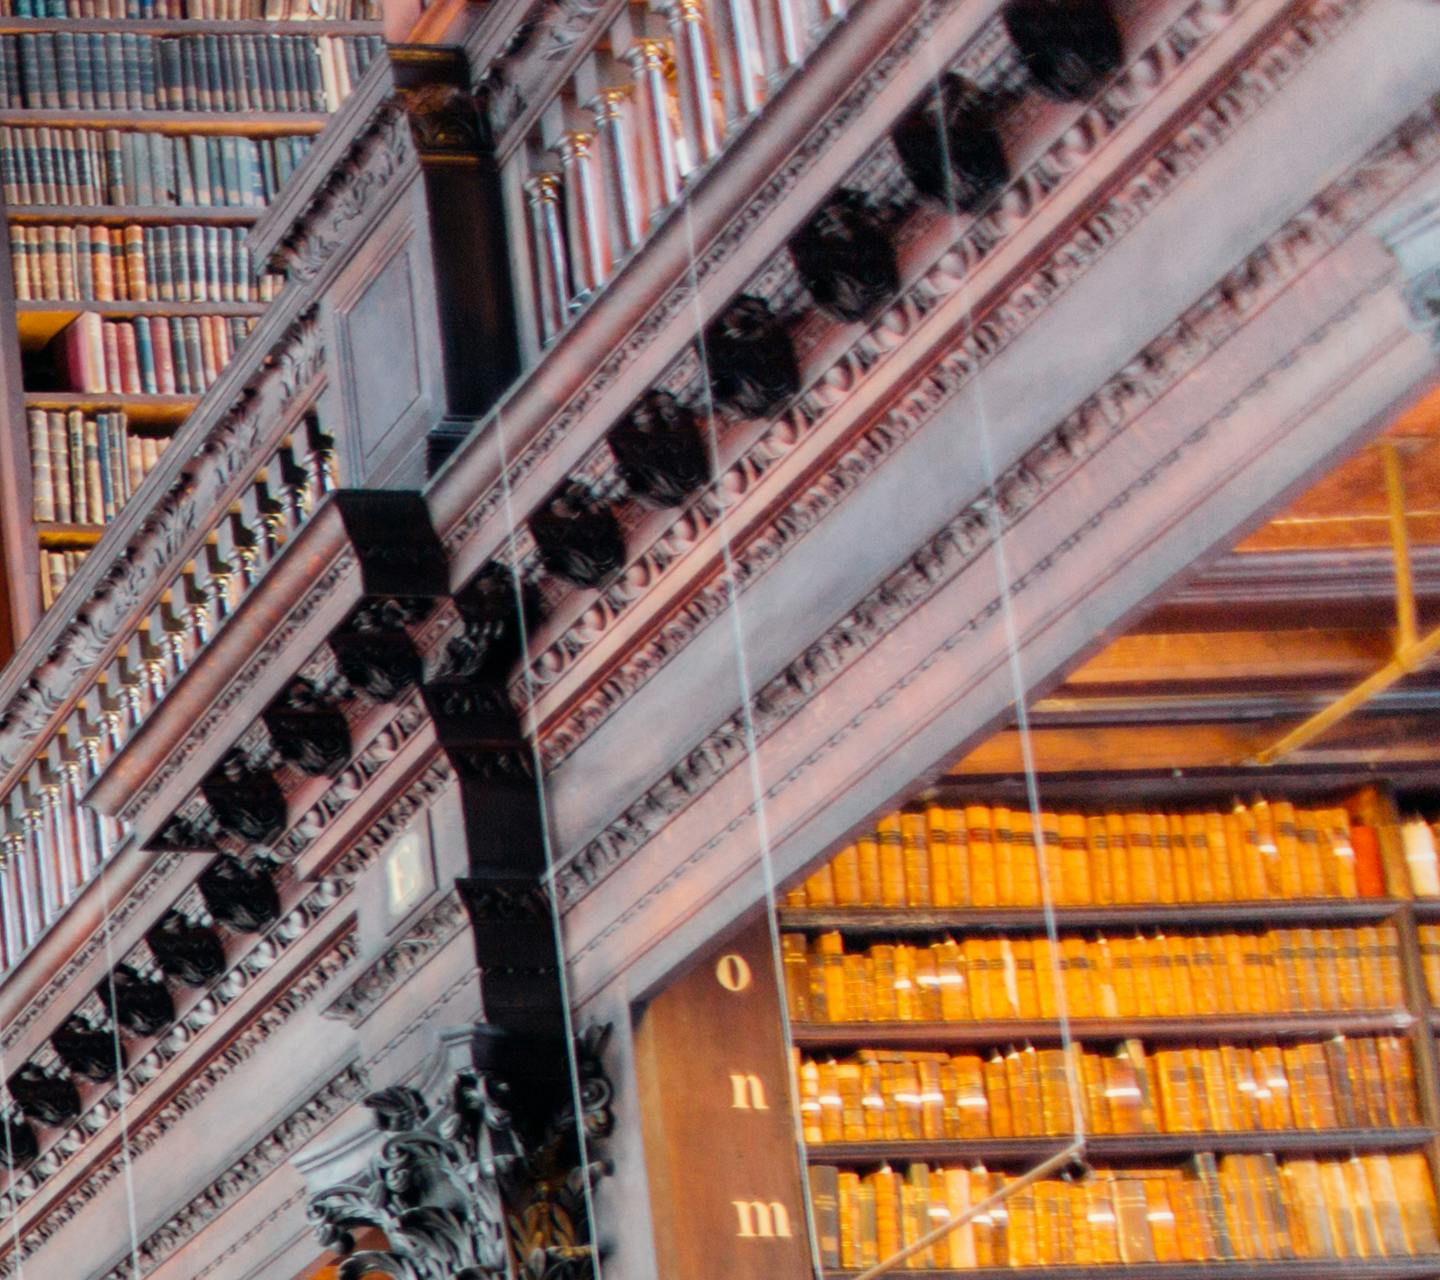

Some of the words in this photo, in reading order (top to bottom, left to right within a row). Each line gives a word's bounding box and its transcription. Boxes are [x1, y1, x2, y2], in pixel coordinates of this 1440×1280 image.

[716, 955, 749, 991] o
[731, 1073, 766, 1110] n
[736, 1200, 792, 1238] m
